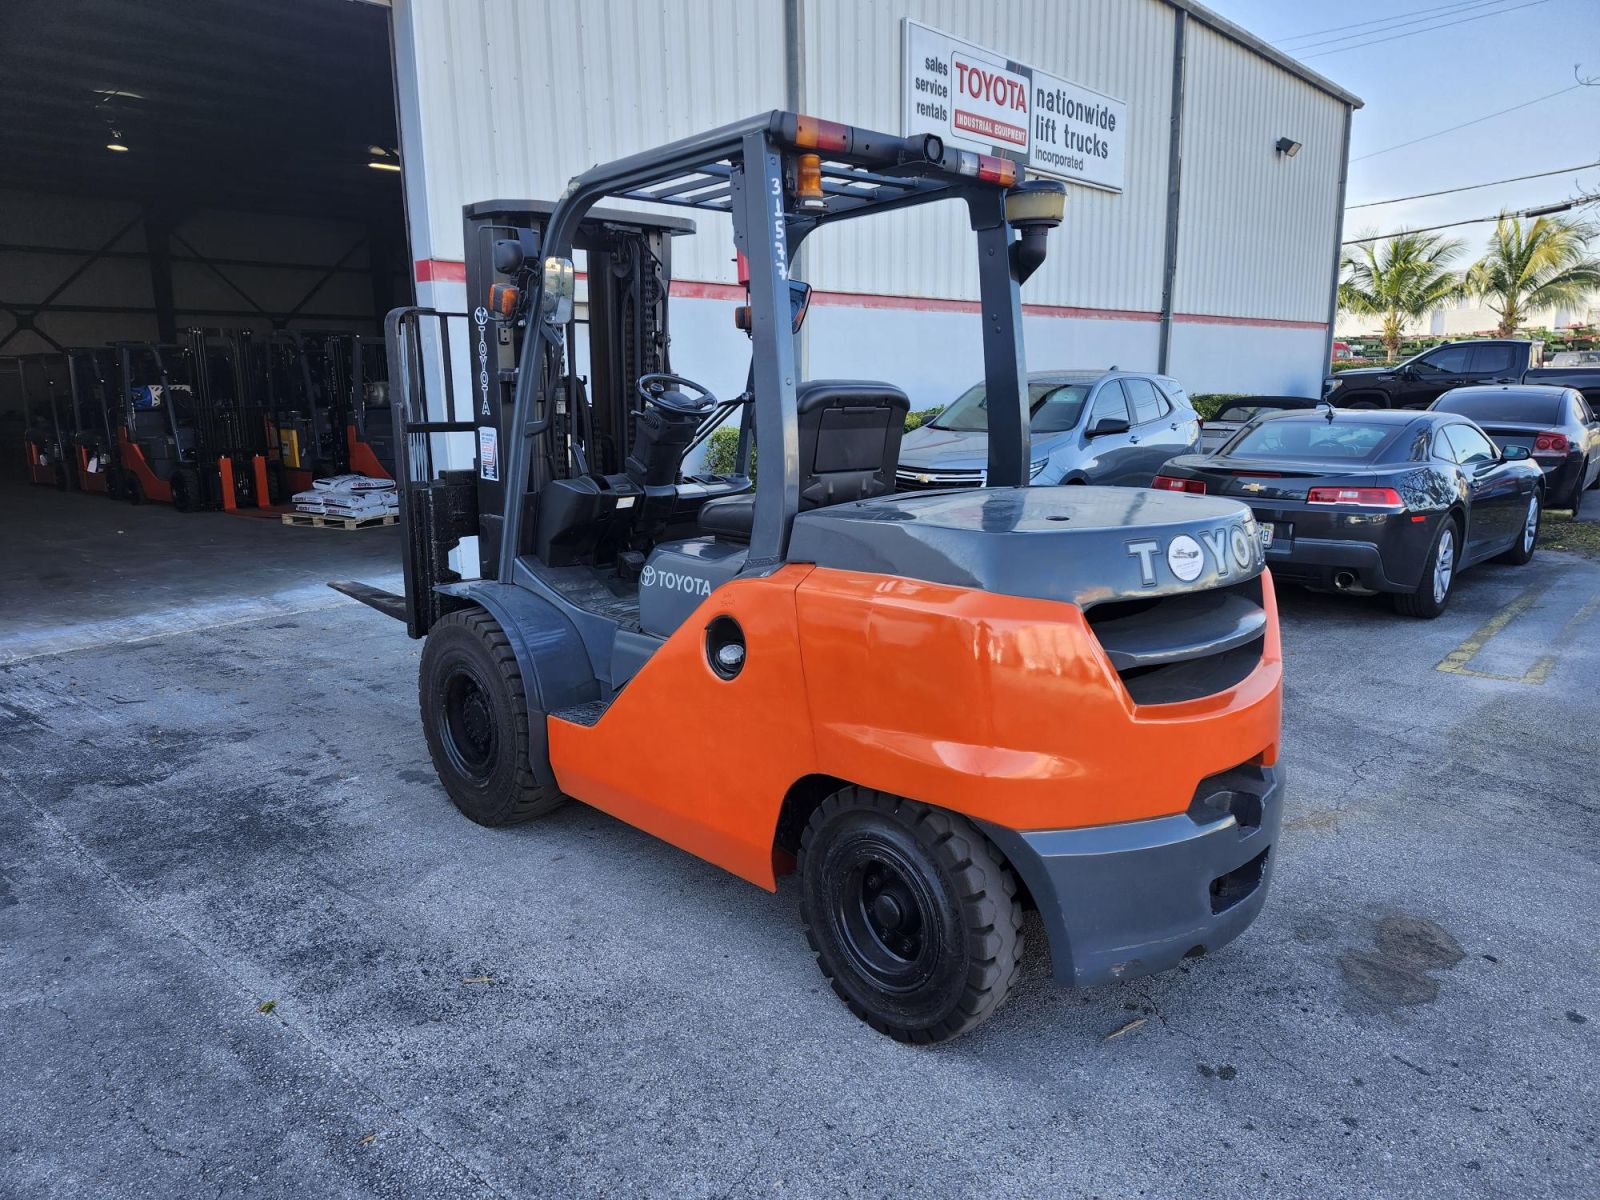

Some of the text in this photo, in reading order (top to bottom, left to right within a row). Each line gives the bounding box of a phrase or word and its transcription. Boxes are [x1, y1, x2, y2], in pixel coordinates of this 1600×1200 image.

[925, 56, 948, 76] sales
[915, 77, 948, 98] service
[955, 61, 1028, 114] TOYOTA
[916, 101, 948, 122] rentals
[1036, 88, 1116, 131] nationwide
[957, 114, 1026, 142] INDUSTRIAL EQUIPMENT
[1035, 114, 1108, 159] lift trucks
[1035, 146, 1084, 171] incorporated
[478, 326, 490, 416] TOYOTA
[658, 570, 712, 597] TOYOTA
